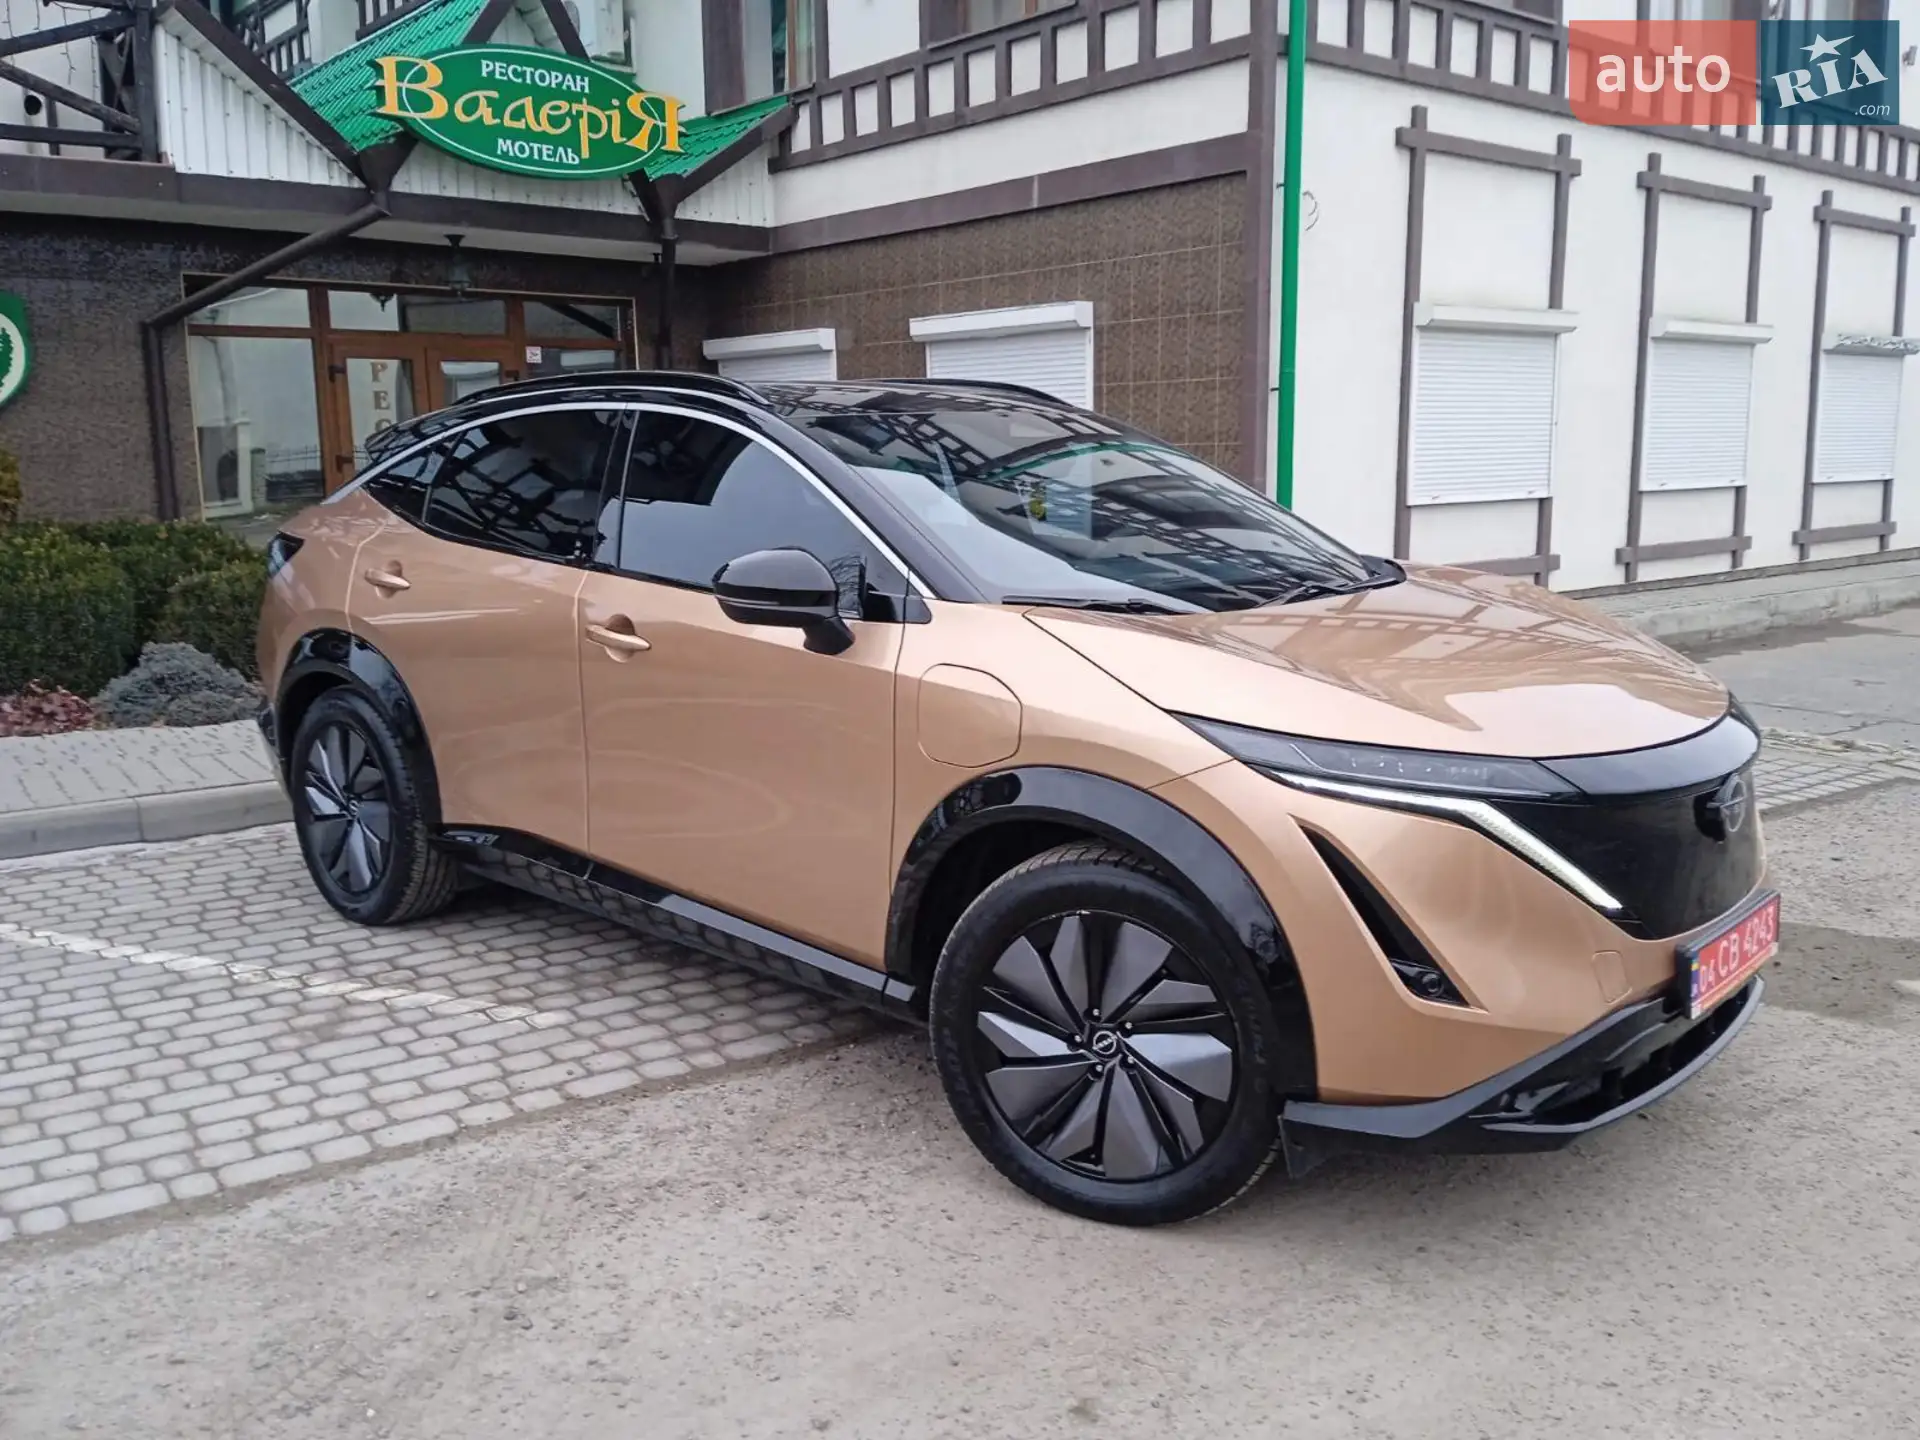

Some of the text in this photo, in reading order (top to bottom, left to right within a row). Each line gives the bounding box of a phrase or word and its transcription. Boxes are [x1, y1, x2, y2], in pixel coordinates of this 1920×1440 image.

[480, 59, 590, 94] РЕСТОРАН
[496, 138, 580, 165] МОТЕЛЬ
[1718, 931, 1740, 978] CB
